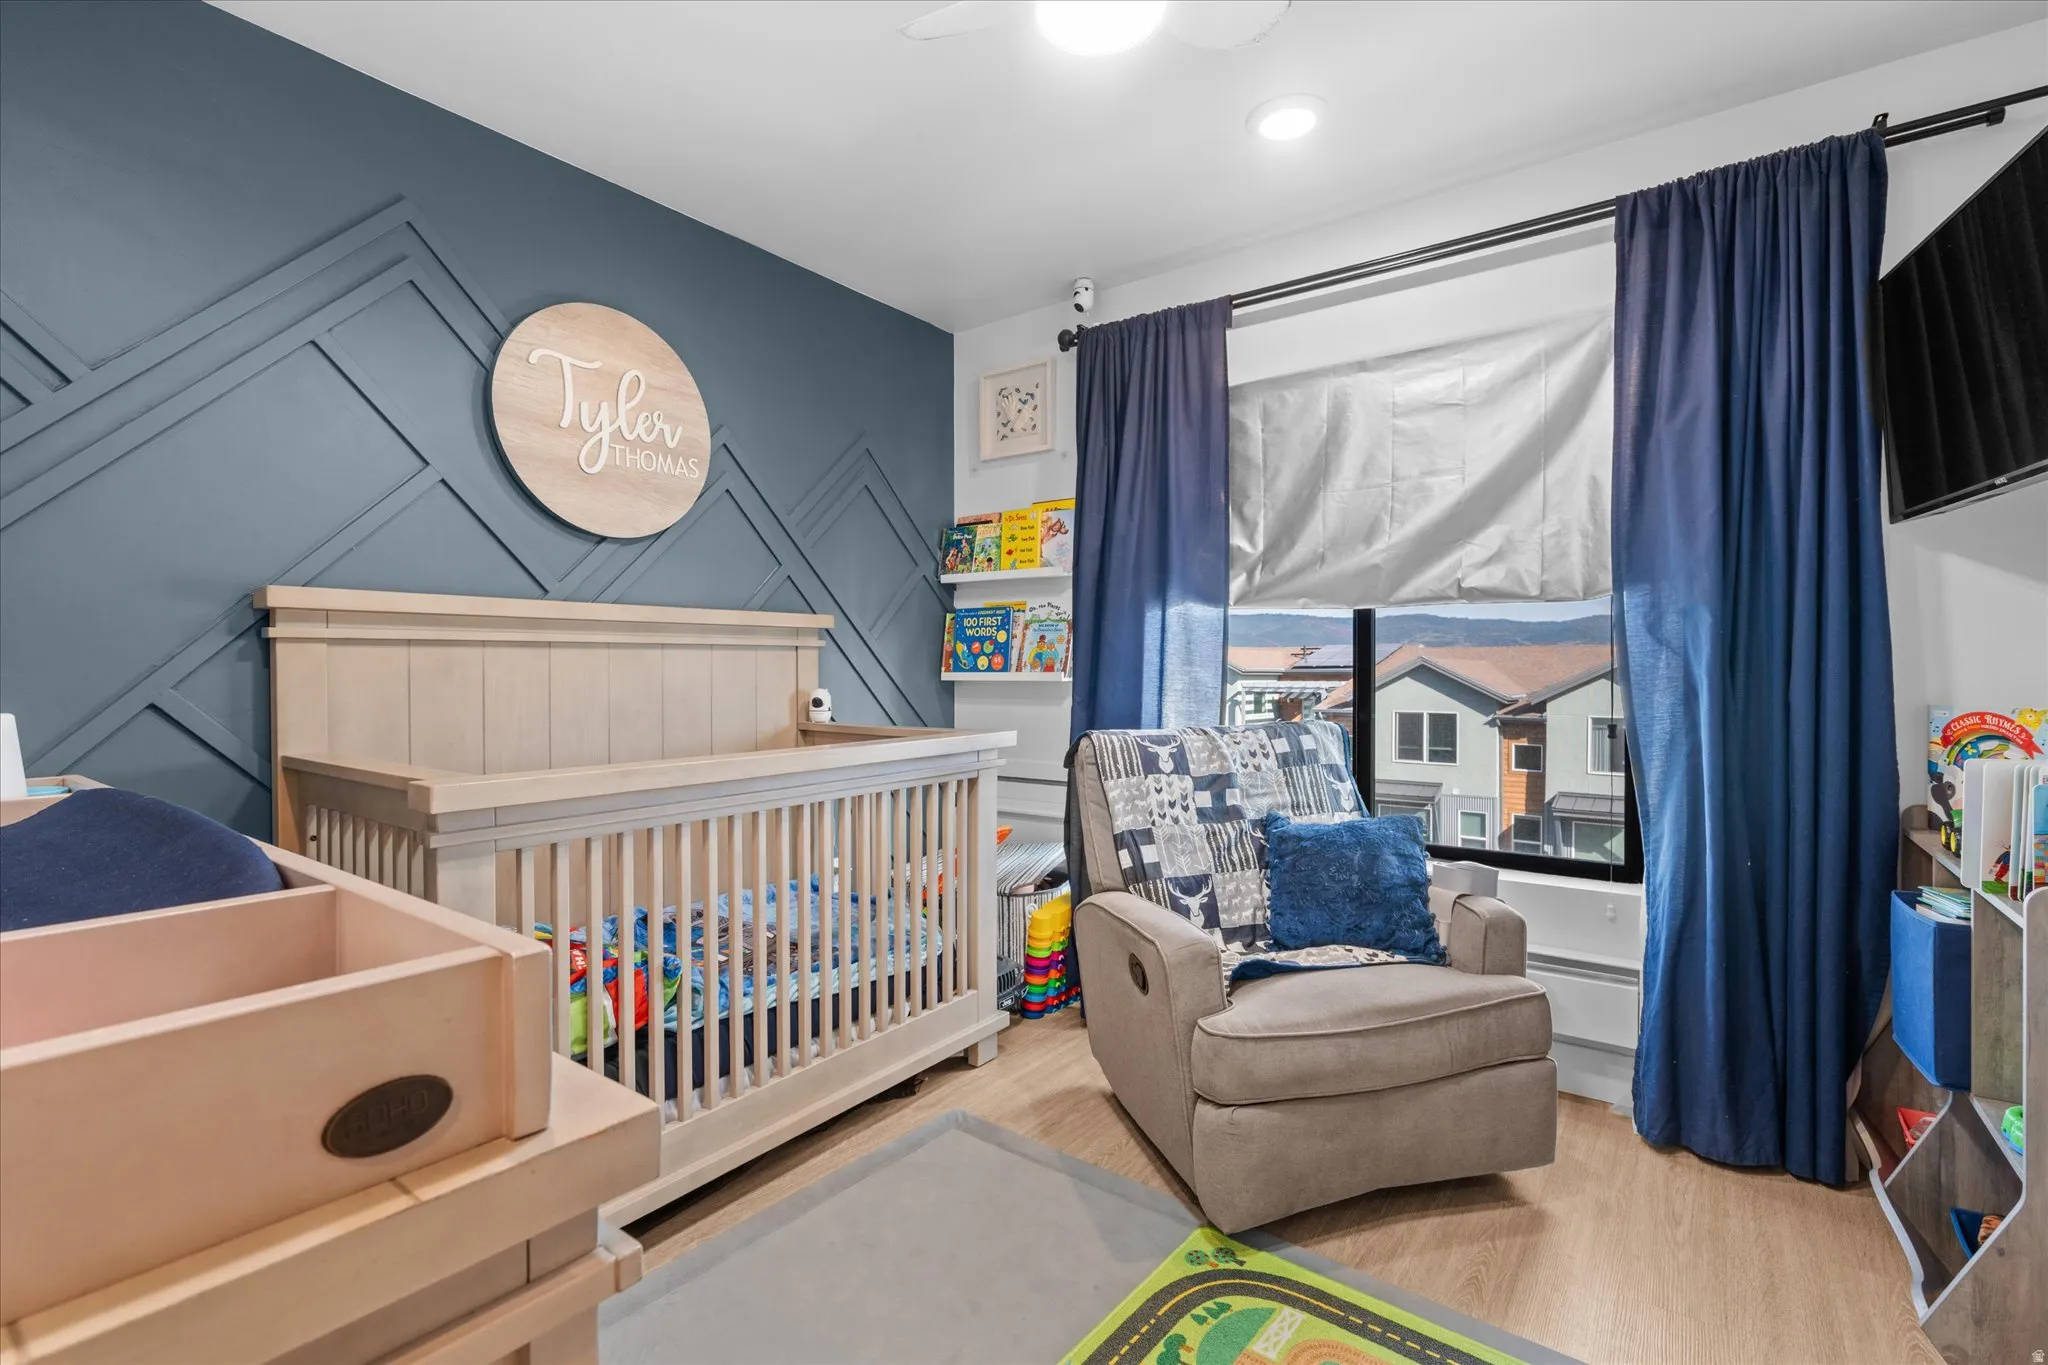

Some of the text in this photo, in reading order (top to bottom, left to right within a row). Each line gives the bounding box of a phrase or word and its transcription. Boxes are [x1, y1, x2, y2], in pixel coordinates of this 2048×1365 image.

[528, 348, 683, 474] Tyler
[610, 443, 700, 479] THOMAS
[963, 616, 1002, 627] 100 FIRST
[965, 627, 998, 637] WORDS
[1950, 715, 1982, 731] CLASSIC
[1984, 714, 2021, 735] RHYMES
